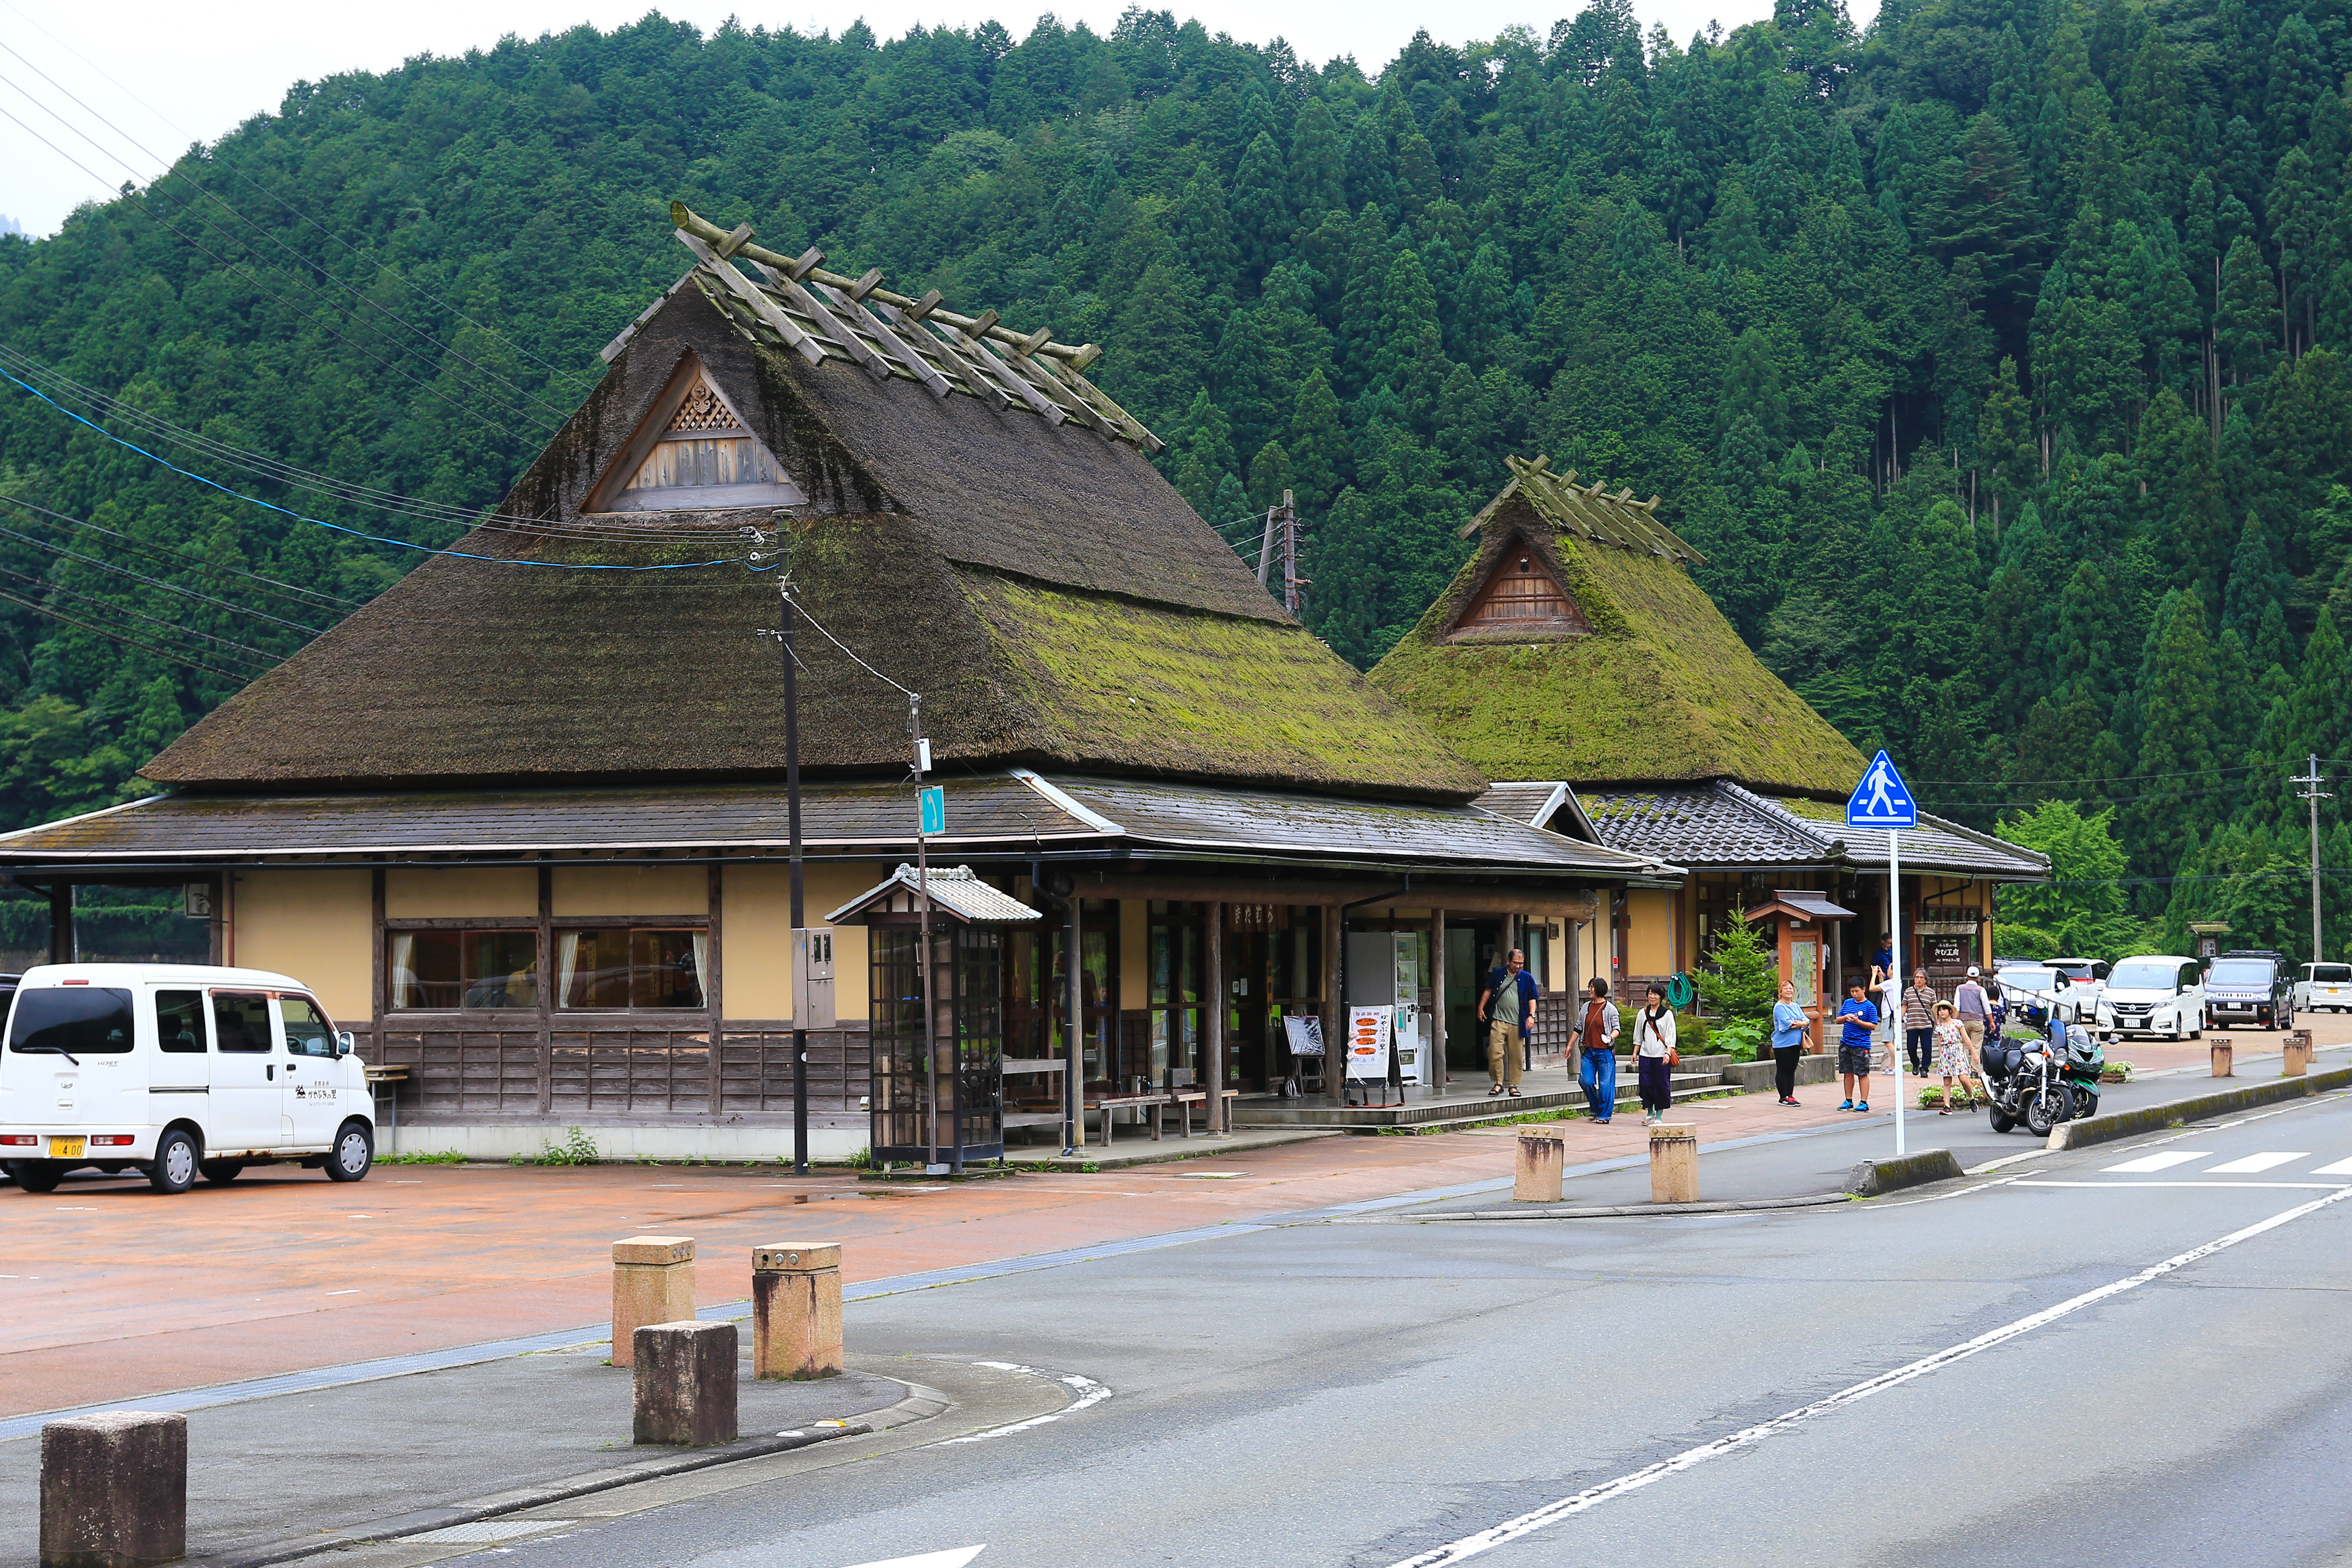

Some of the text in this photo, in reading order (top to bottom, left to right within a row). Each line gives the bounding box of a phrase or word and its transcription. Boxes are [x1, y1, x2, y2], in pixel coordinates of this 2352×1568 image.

[1235, 904, 1273, 924] きたむら
[308, 1088, 337, 1099] かやぶきの里
